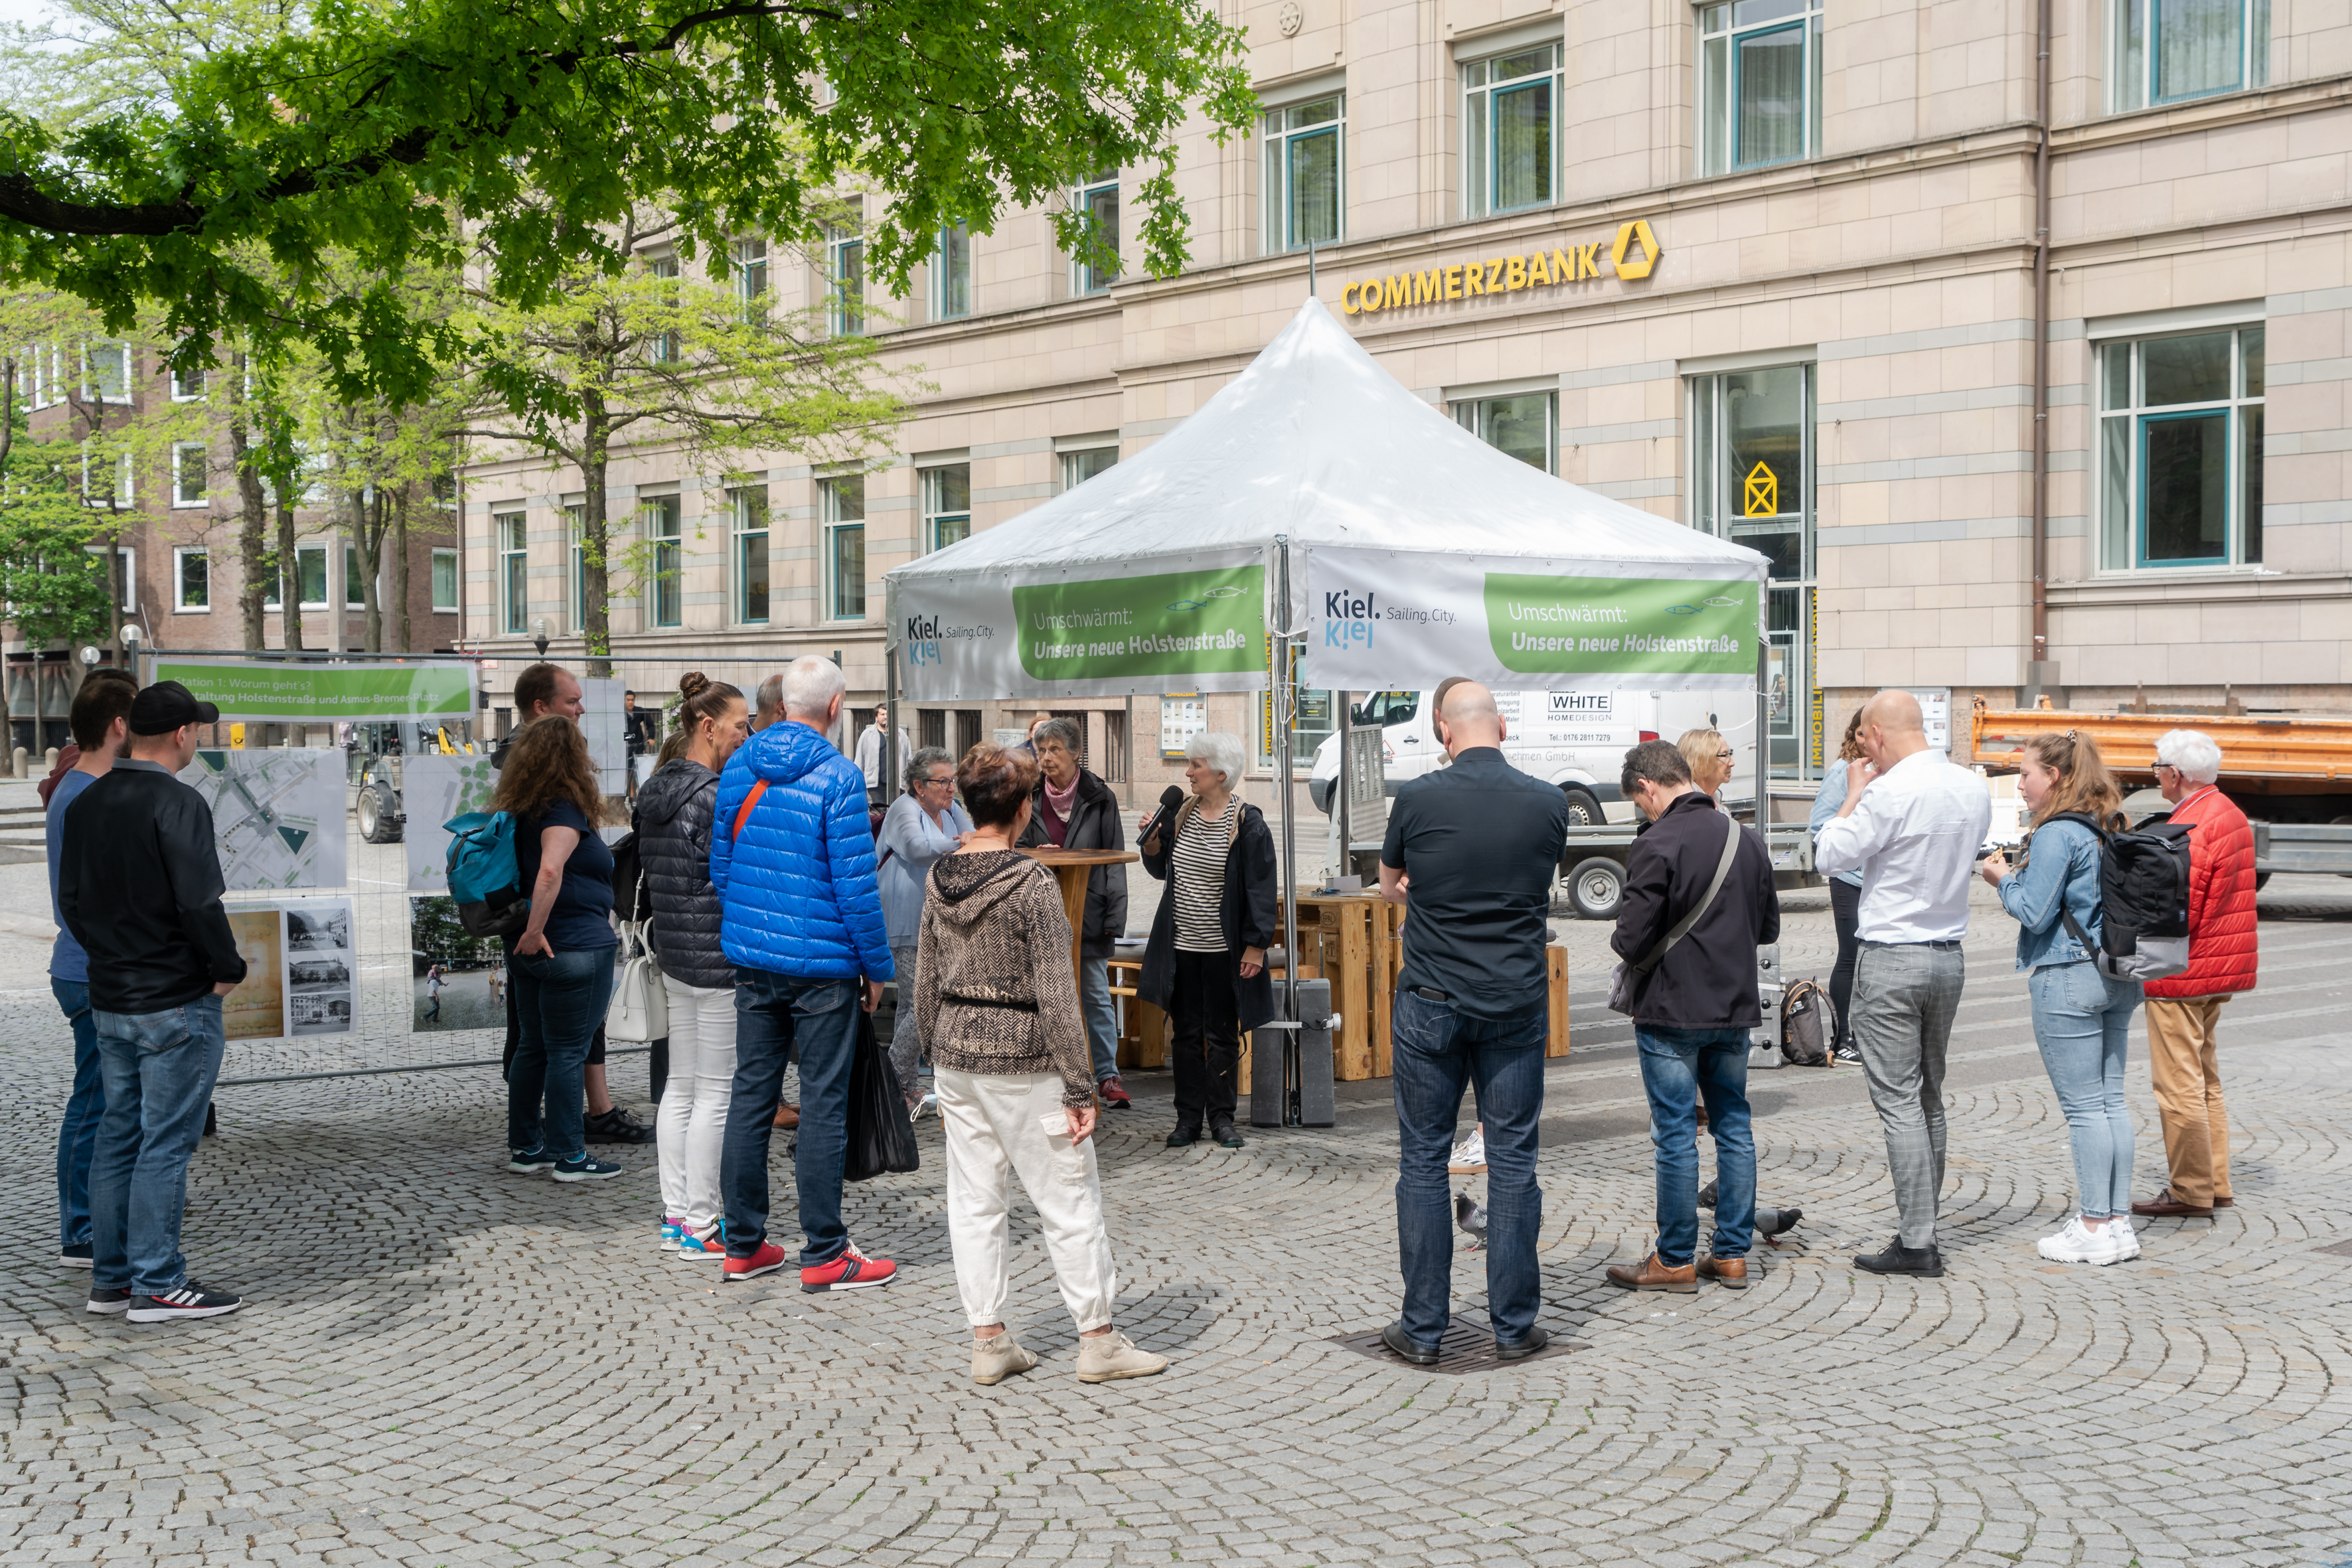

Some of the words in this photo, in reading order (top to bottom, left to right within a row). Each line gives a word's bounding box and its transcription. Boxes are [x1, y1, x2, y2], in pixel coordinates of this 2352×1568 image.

[1341, 242, 1602, 315] COMMERZBANK
[1326, 589, 1380, 619] Kiel.
[1508, 601, 1628, 623] Umschwärmt:
[908, 614, 942, 641] Kiel.
[1034, 607, 1133, 630] Umschwärmt:
[1034, 641, 1085, 659] Unsere
[1088, 641, 1125, 657] neue
[1129, 628, 1245, 654] Holstenstraße
[1512, 632, 1574, 651] Unsere
[1579, 637, 1620, 653] neue
[1623, 633, 1739, 653] Holstenstraße
[174, 676, 214, 687] Station
[217, 678, 226, 687] 1:
[229, 678, 270, 688] Worum
[193, 692, 235, 703] taltung
[238, 693, 317, 704] Holstenstraße
[340, 692, 439, 704] Asmus-Bremer-Platz
[1553, 696, 1608, 708] WHITE
[1545, 751, 1575, 761] GmbH
